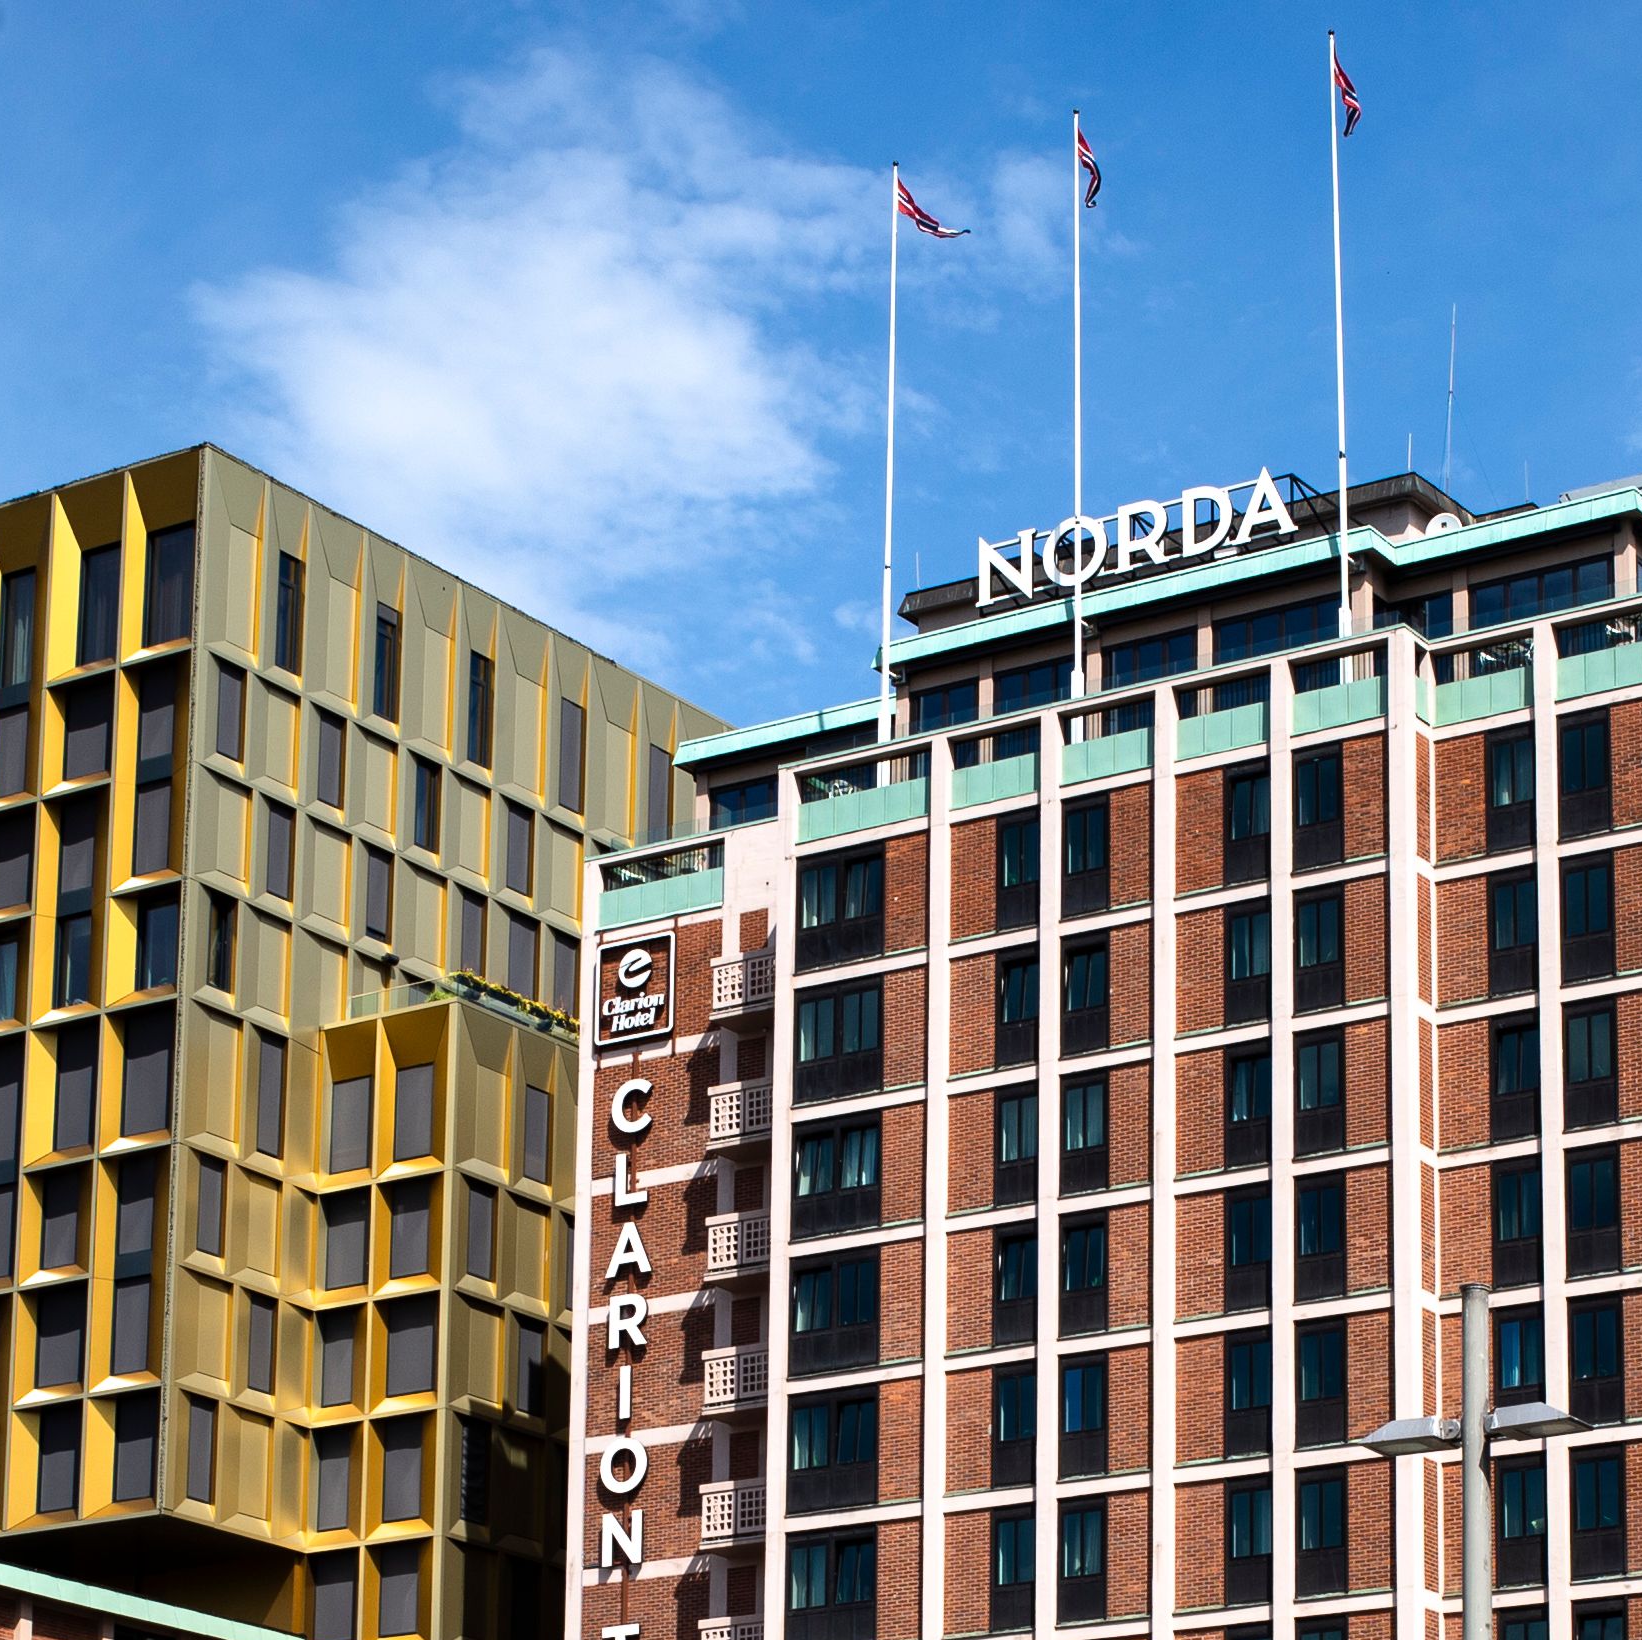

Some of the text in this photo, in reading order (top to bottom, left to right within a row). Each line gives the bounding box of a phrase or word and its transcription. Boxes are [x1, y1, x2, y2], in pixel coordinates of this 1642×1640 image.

[976, 467, 1298, 608] NORDA
[603, 991, 665, 1016] Clarion
[611, 1007, 656, 1033] Hotel
[600, 1078, 654, 1568] CLARION
